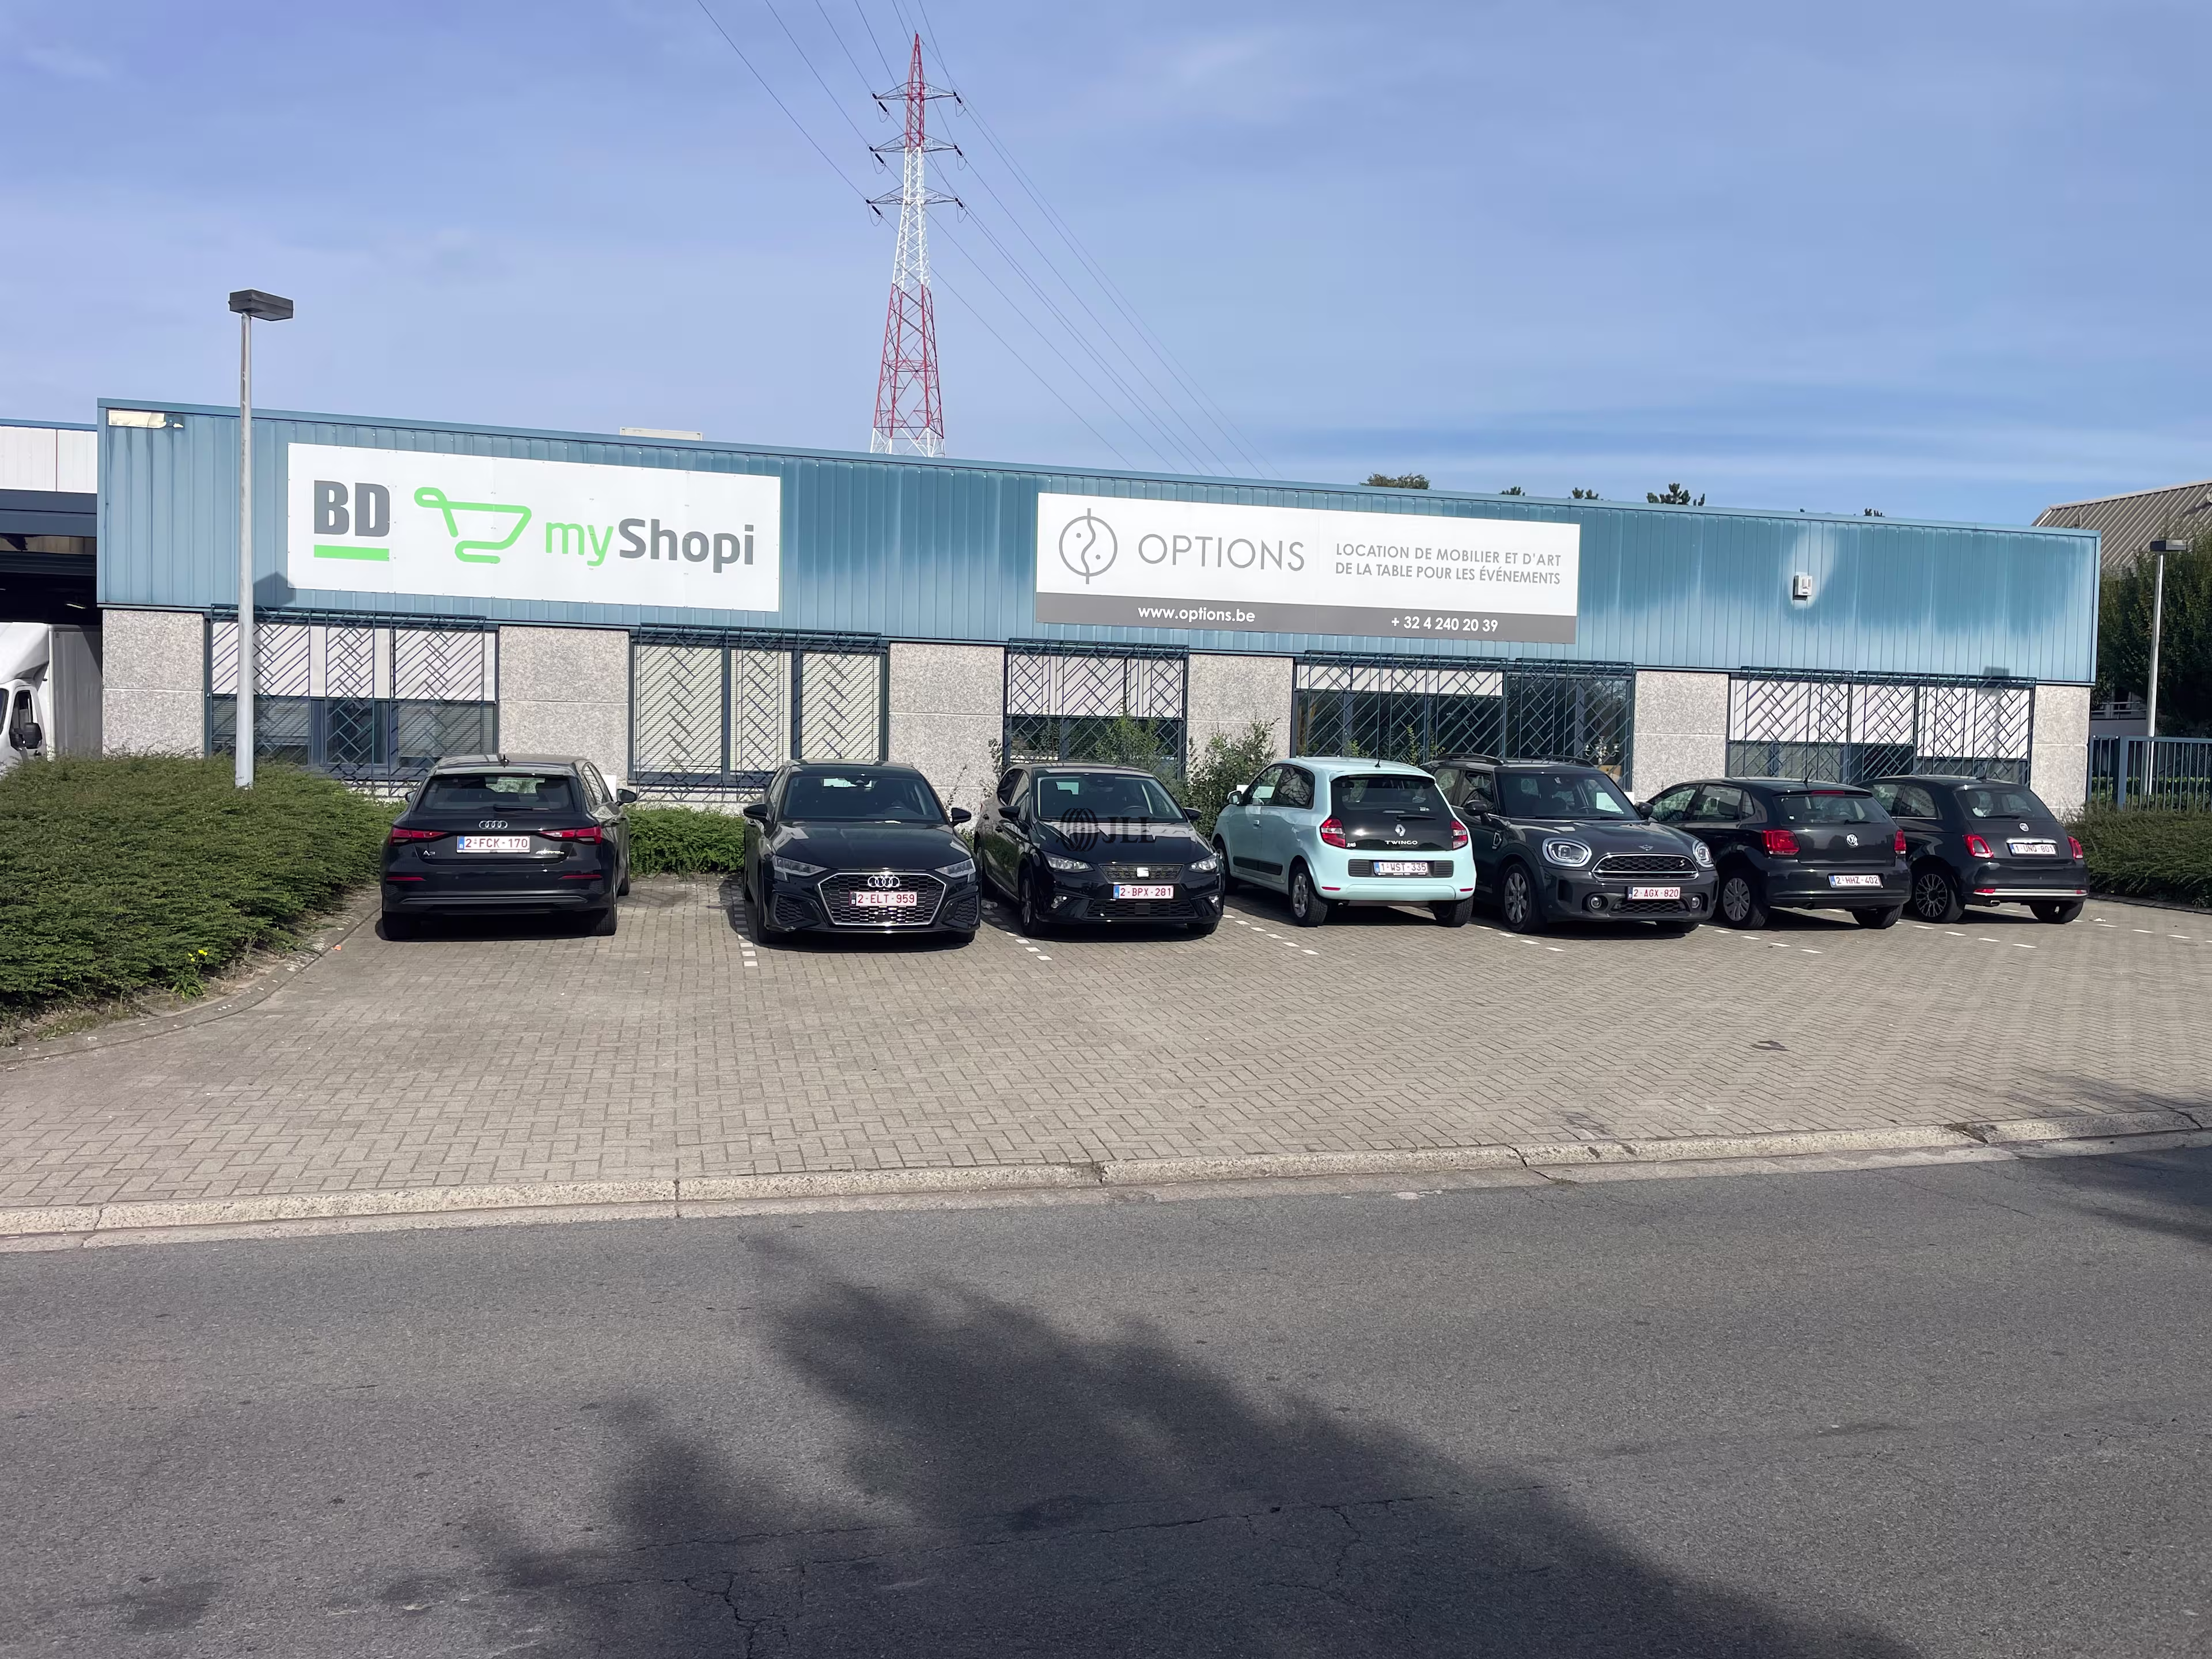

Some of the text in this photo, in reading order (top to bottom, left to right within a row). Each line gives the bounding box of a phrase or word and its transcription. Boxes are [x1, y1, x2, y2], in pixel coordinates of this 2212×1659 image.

[314, 480, 389, 537] BD
[546, 518, 753, 573] myShopi
[1138, 533, 1305, 571] OPTIONS
[1336, 543, 1561, 567] LOCATION DE MOBILIER ET D'ART
[1335, 562, 1560, 585] DE LA TABLE POUR LES ÉVÉNEMENTS
[1138, 607, 1256, 623] www.options.be
[1391, 616, 1498, 632] + 32 4 240 20 39
[858, 894, 914, 903] 2-ELT-959
[1120, 888, 1171, 896] 2-BPX-281
[1634, 889, 1679, 897] 2-AGX-820
